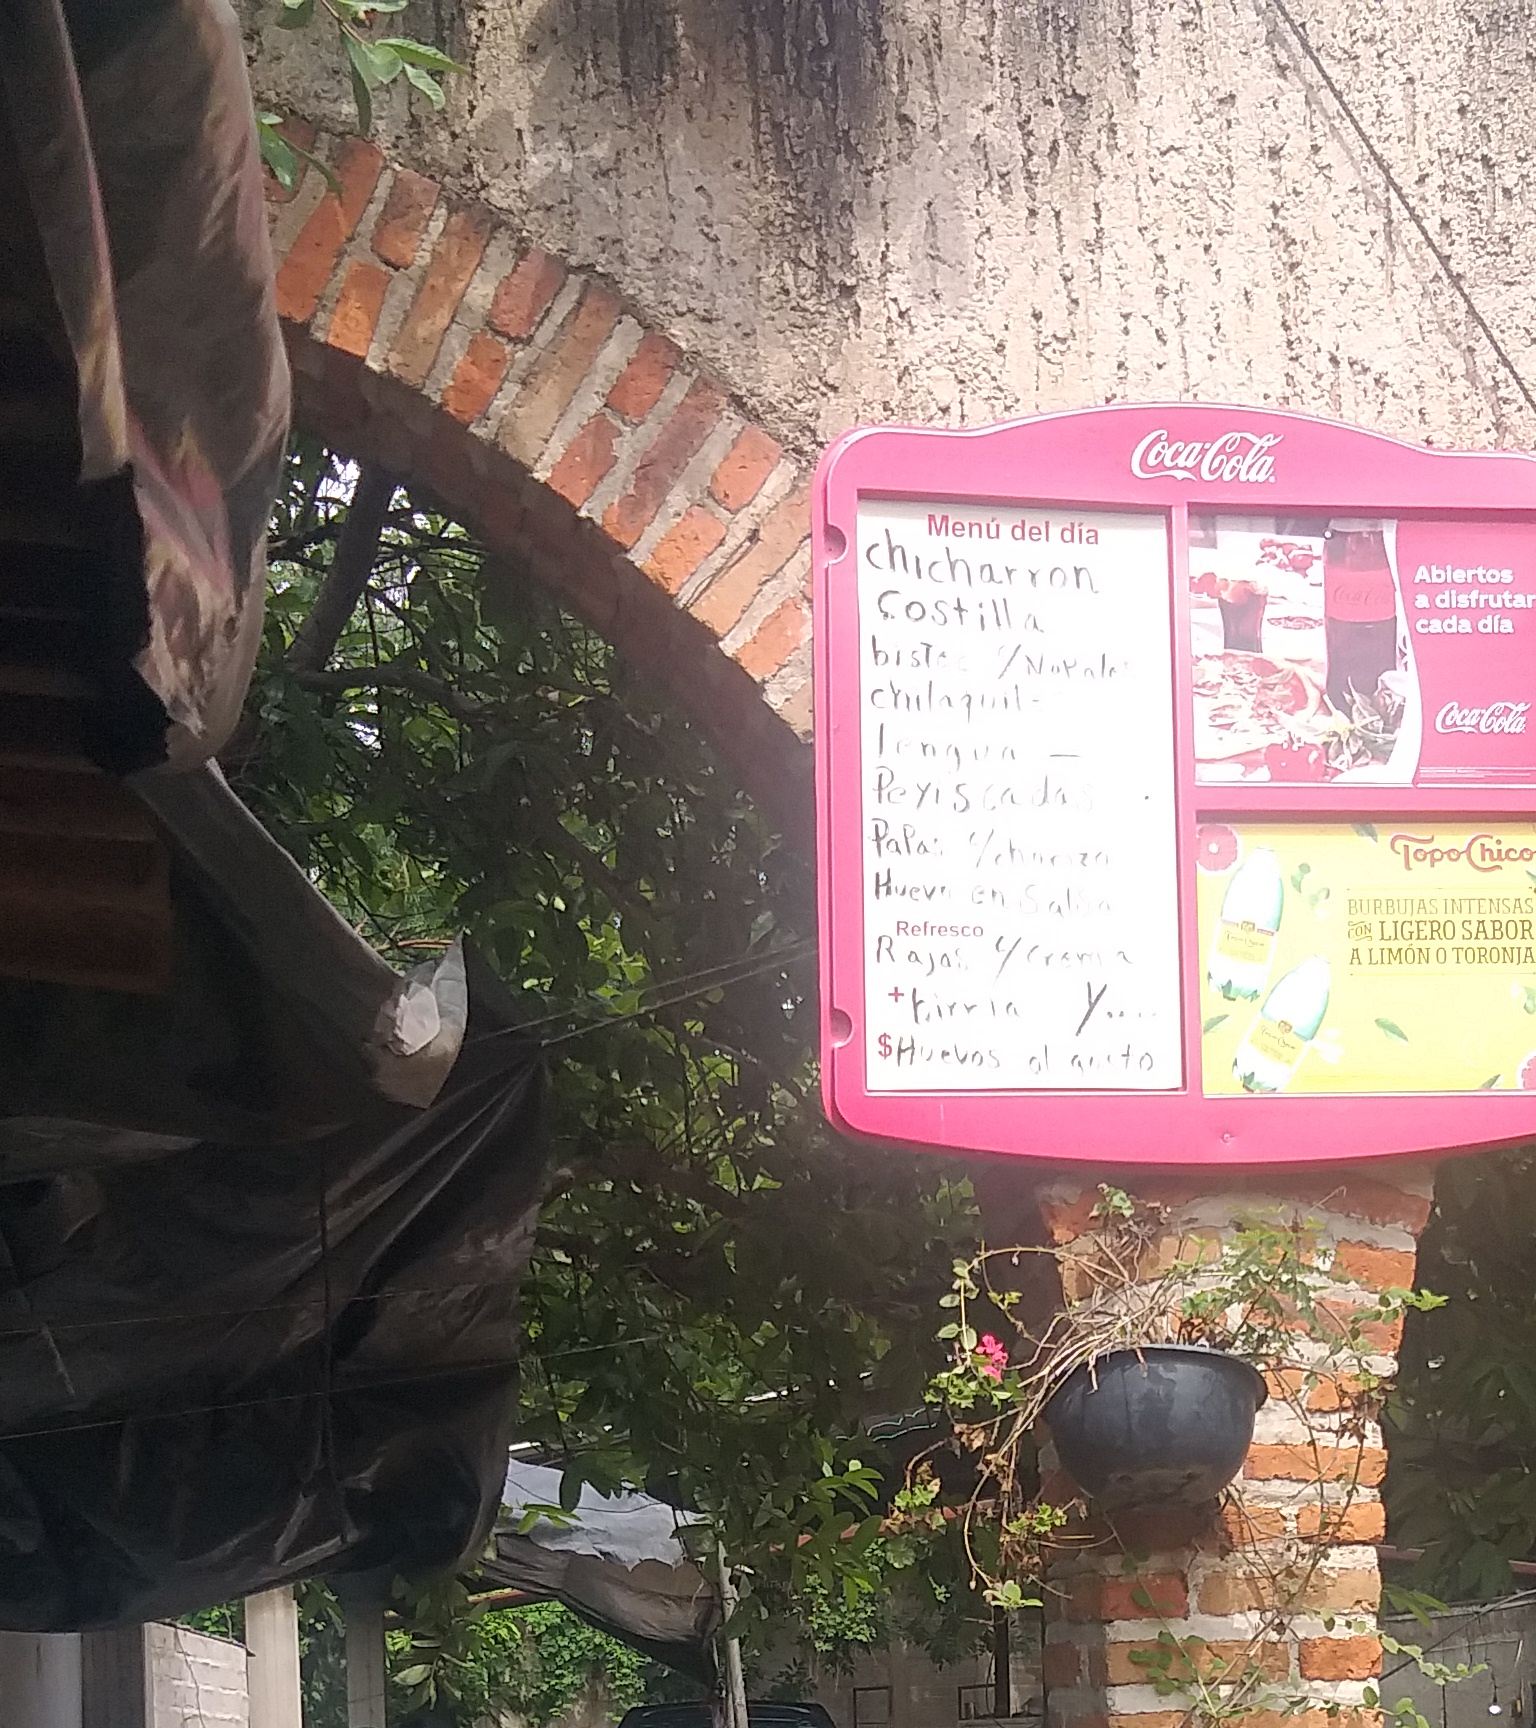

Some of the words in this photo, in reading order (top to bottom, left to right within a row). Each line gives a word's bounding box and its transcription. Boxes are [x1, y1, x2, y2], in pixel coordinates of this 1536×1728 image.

[1130, 429, 1284, 483] Coca-Cola
[927, 514, 1001, 540] Menú
[1010, 519, 1050, 542] del
[1060, 521, 1099, 545] día
[866, 528, 1099, 594] chicharron
[1414, 564, 1515, 584] Abiertos
[1414, 594, 1430, 609] a
[1435, 590, 1536, 609] disfrutar
[1415, 615, 1473, 634] cada
[1477, 615, 1515, 634] día
[1434, 701, 1532, 734] Coca-Cola
[1390, 834, 1466, 871] Topo
[1347, 898, 1438, 917] BURBUJAS
[1443, 897, 1535, 915] INTENSAS
[896, 920, 984, 938] Refresco
[1347, 922, 1373, 940] CON
[1379, 919, 1456, 941] LIGERO
[1461, 919, 1535, 941] SABOR
[1349, 947, 1363, 965] A
[1368, 943, 1431, 965] LIMÓN
[1436, 947, 1447, 965] O
[1452, 946, 1536, 966] TORONJA
